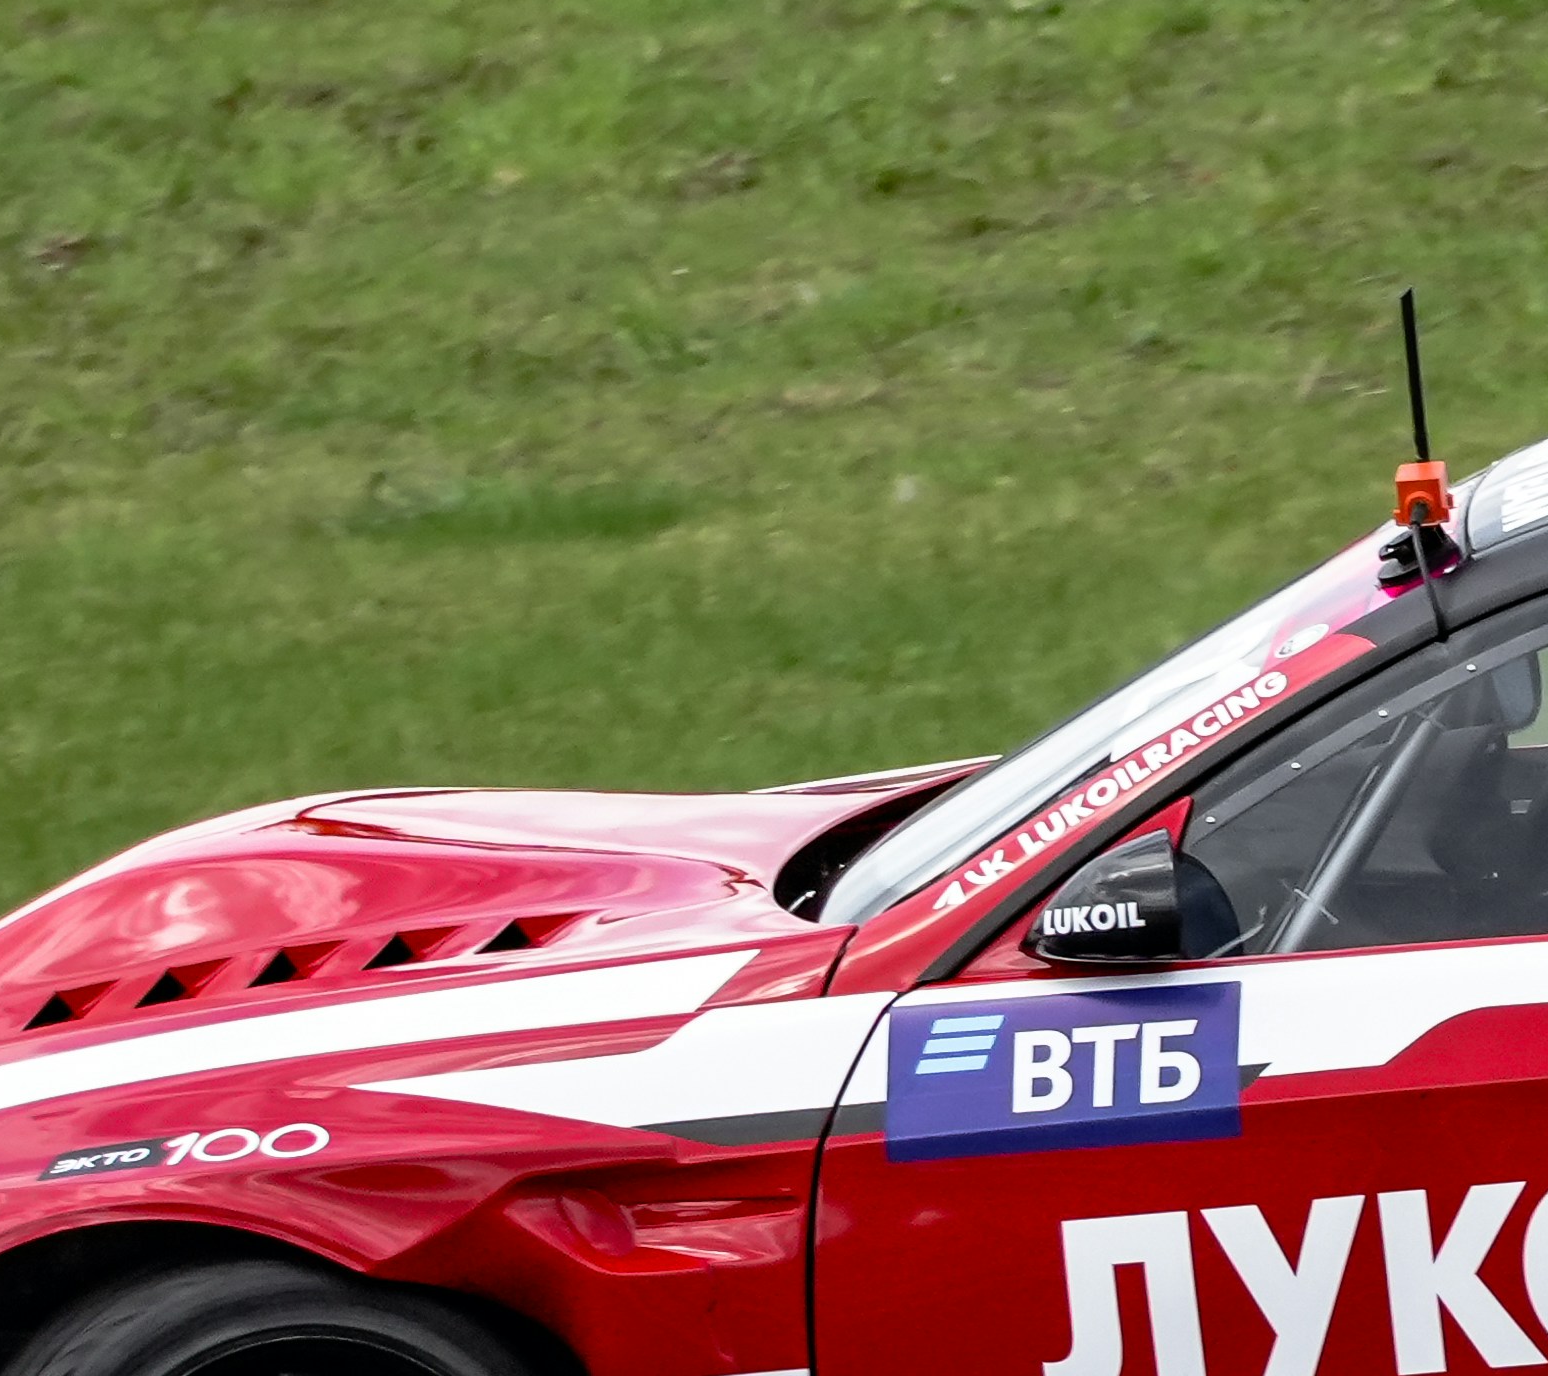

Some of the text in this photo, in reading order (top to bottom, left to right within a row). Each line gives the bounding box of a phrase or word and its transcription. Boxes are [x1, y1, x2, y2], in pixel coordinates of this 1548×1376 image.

[1016, 670, 1289, 857] LUKOILRACING
[1042, 901, 1146, 936] LUKOIL
[1012, 1018, 1201, 1113] ВТБ
[48, 1122, 330, 1175] ЭКТО 100
